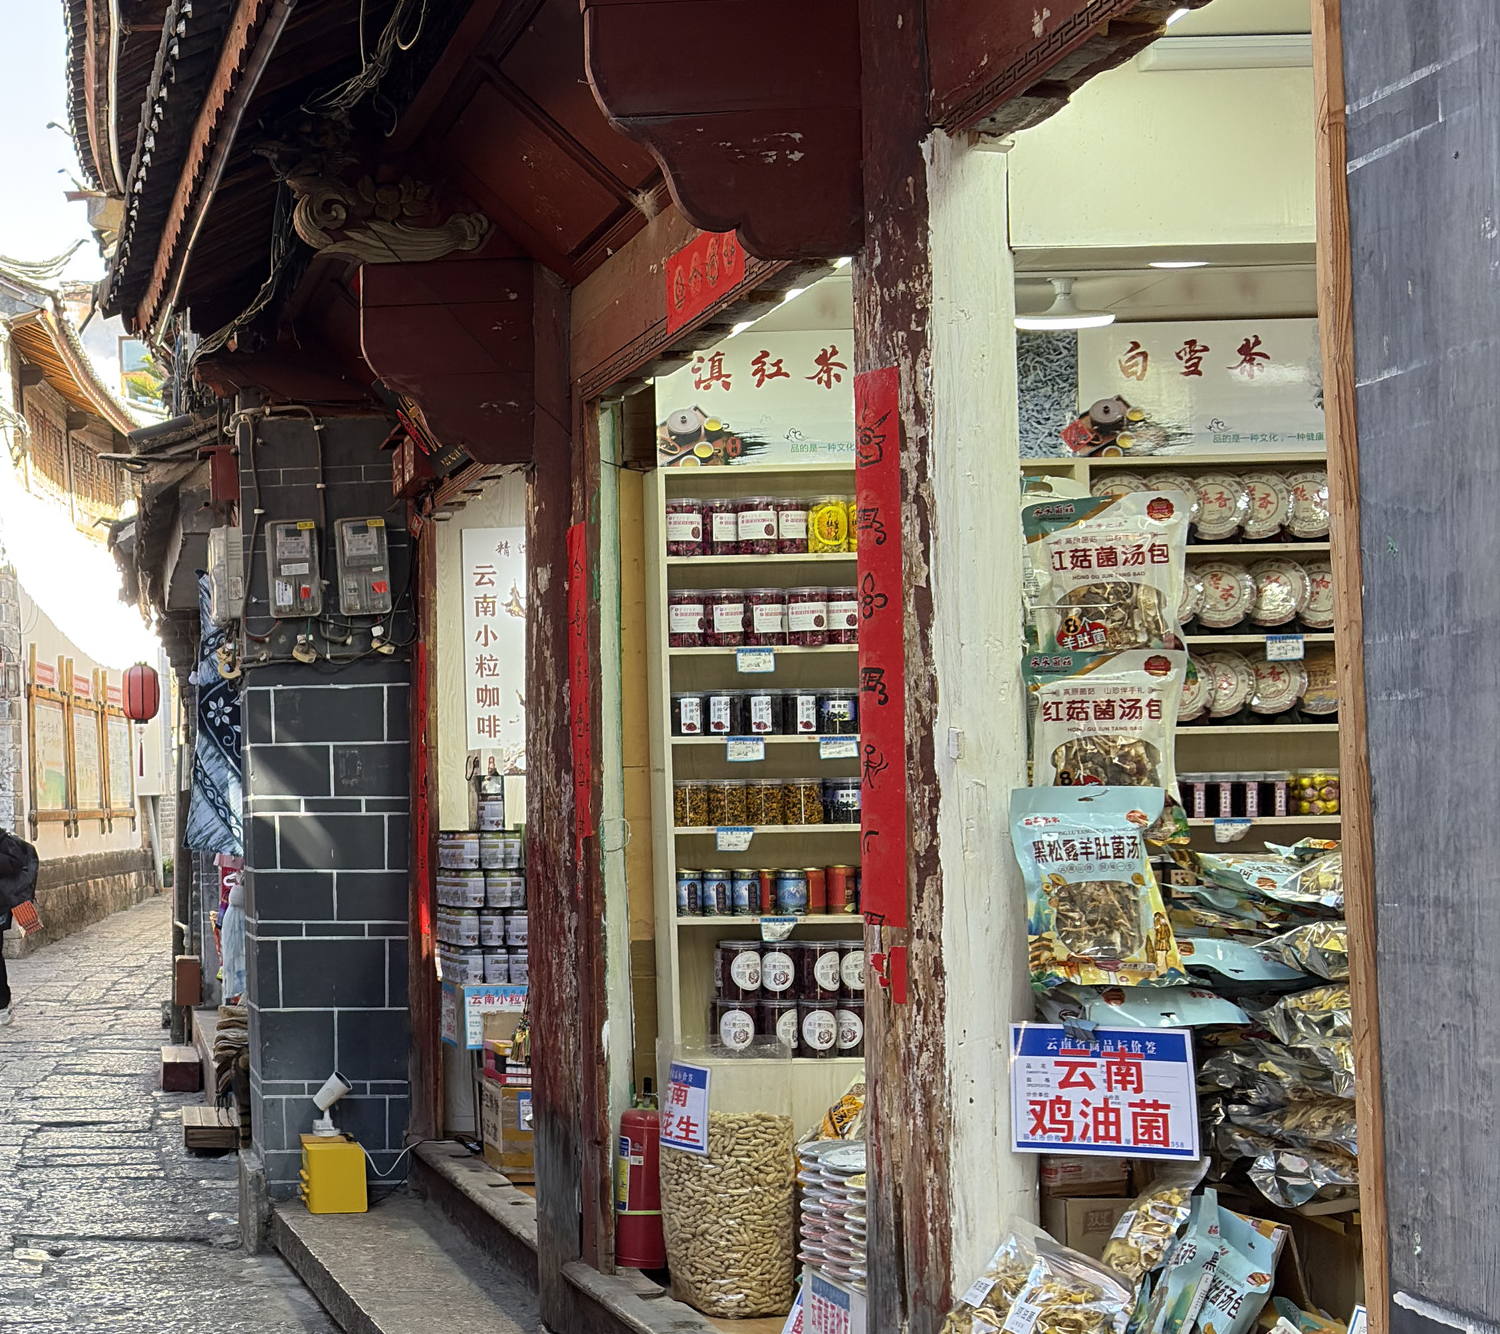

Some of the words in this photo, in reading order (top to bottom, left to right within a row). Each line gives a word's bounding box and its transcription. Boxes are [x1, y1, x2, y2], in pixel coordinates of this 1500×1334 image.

[691, 345, 848, 391] 滇红茶
[1118, 334, 1271, 381] 白雪茶
[791, 443, 855, 453] 品的是一种文化
[473, 564, 502, 738] 云南小粒咖啡
[1062, 628, 1107, 651] 羊肚菌
[1043, 698, 1163, 723] 红菇菌汤包
[1054, 1047, 1145, 1094] 云南
[1028, 1095, 1171, 1148] 鸡油菌
